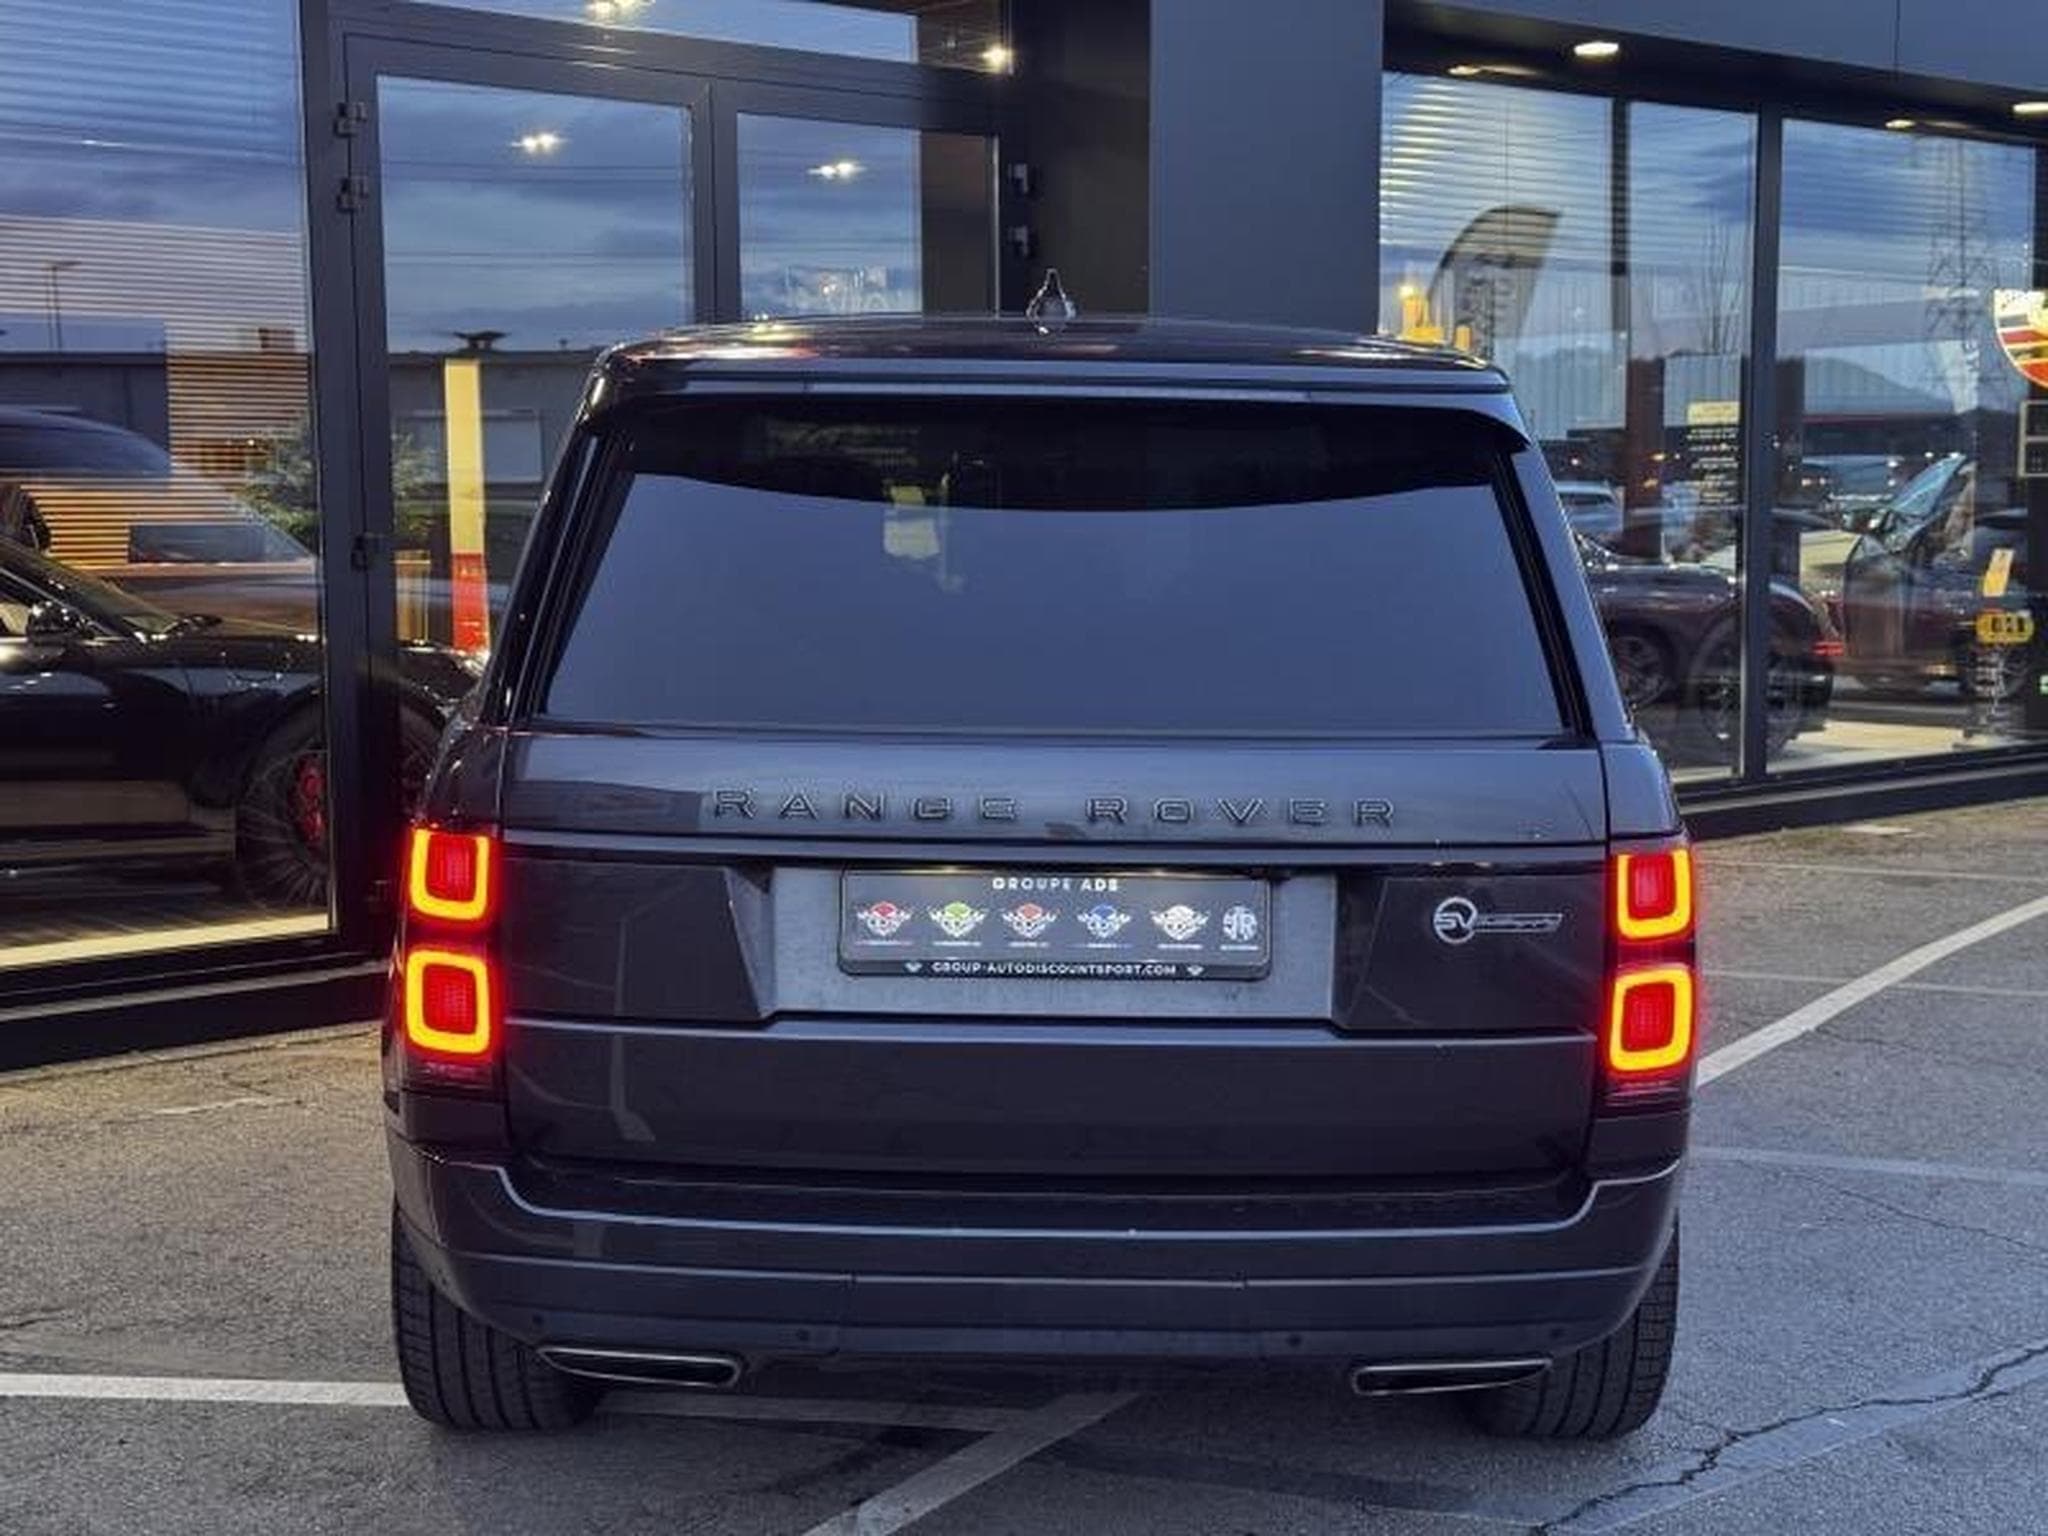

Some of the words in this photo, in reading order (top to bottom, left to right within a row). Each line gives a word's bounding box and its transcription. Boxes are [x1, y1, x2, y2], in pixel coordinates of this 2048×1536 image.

[713, 787, 1018, 821] RANGE
[1085, 796, 1395, 827] ROVER
[992, 877, 1072, 891] GROUPE
